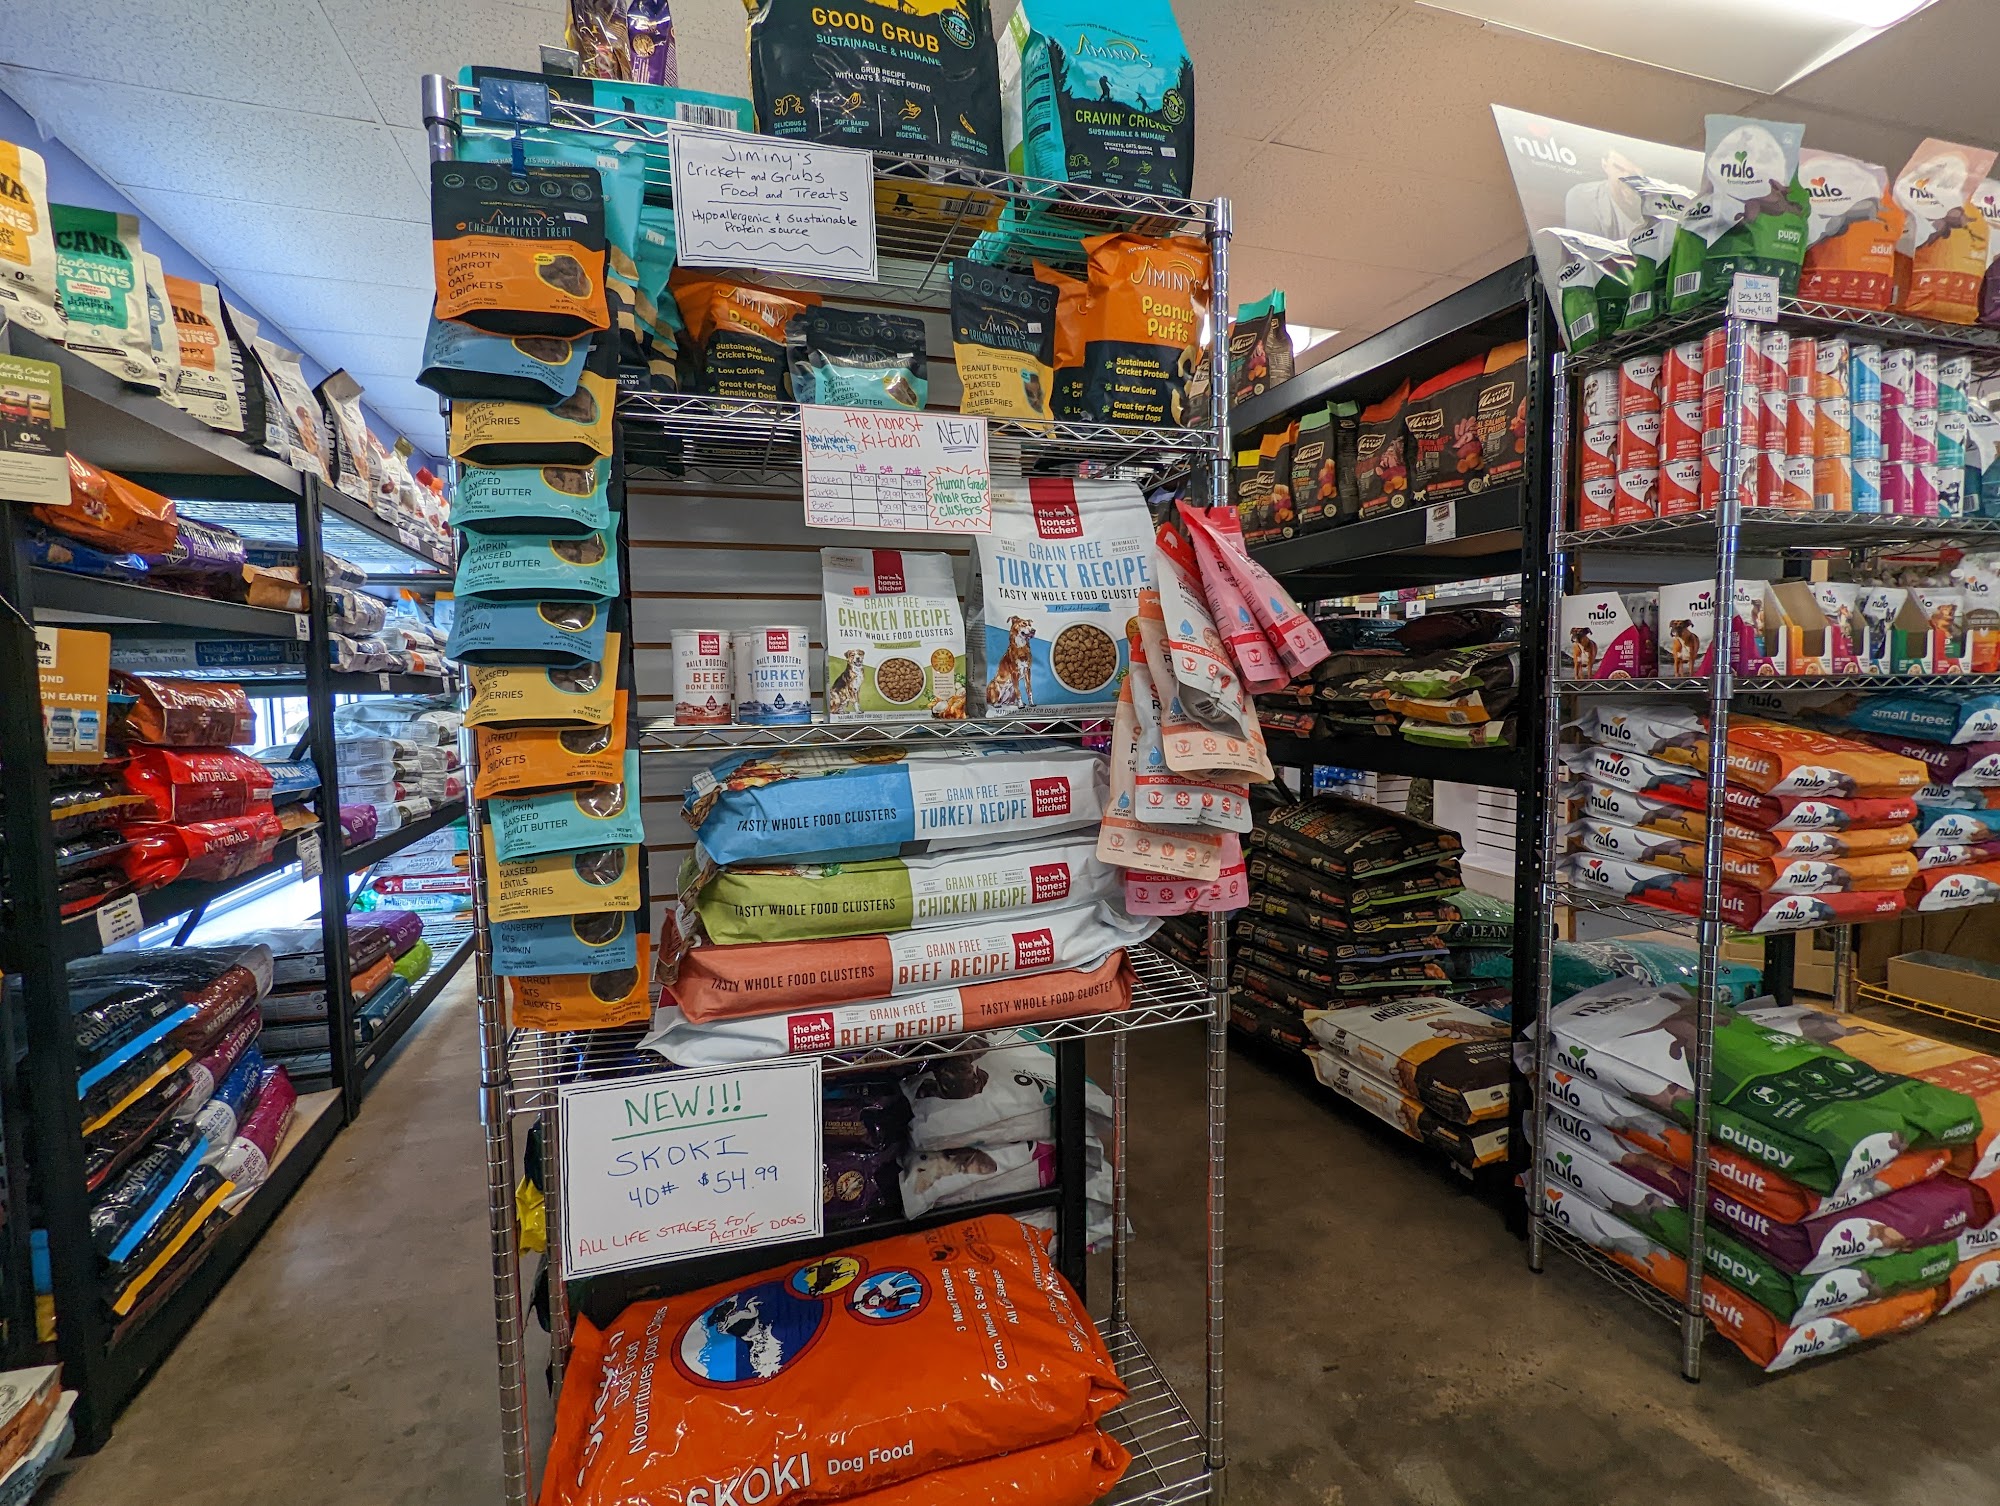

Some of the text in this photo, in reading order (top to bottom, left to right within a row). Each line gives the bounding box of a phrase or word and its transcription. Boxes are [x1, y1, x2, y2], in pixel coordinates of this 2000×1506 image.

[811, 7, 940, 54] GOOD GRUB
[948, 21, 967, 37] USA
[816, 33, 942, 67] SUSTAINABLE & HUMANE
[860, 65, 906, 80] GRUB RECIPE
[834, 71, 854, 80] WITH
[855, 73, 874, 82] OATS
[881, 75, 906, 88] SWEET
[906, 80, 931, 94] POTATO
[773, 119, 801, 130] DELICIOUS
[834, 118, 870, 128] SOFT BAKED
[901, 123, 922, 133] HIGHLY
[1075, 109, 1174, 134] CRAVIN' CRICKET
[841, 125, 863, 135] KIBBLE
[895, 130, 929, 142] DIGESTIBLE
[1088, 127, 1134, 139] SUSTAINABLE
[1140, 131, 1166, 143] HUMANE
[1513, 134, 1578, 167] nulo
[687, 161, 826, 184] Cricket and Grubs
[1719, 158, 1755, 180] nulo
[720, 183, 849, 203] Food and Treats
[691, 208, 772, 229] Hypoallergenic
[504, 225, 542, 238] CRICKET
[545, 226, 572, 238] TREAT
[724, 220, 812, 238] Protein source
[447, 251, 501, 266] PUMPKIN
[447, 260, 493, 277] CARROT
[1558, 260, 1581, 284] nulo
[448, 272, 475, 288] OATS
[449, 280, 504, 301] CRICKETS
[1141, 295, 1195, 325] Peanut
[1146, 317, 1189, 344] Puffs
[961, 364, 1019, 374] PEANUT BUTTER
[1115, 356, 1160, 371] Sustainable
[1632, 365, 1656, 377] nulo
[962, 371, 999, 381] CRICKETS
[1115, 366, 1170, 380] Cricket Protein
[1114, 384, 1157, 397] Low Calorie
[966, 398, 1014, 408] BLUEBERRIES
[1113, 401, 1164, 414] Great for Food
[844, 412, 924, 432] the honest
[1111, 409, 1162, 423] Sensitive Dogs
[936, 420, 980, 445] NEW
[1590, 433, 1611, 444] nulo
[861, 432, 921, 450] Kitchen
[879, 465, 894, 475] 5#
[1676, 467, 1701, 479] nulo
[935, 477, 988, 491] Human Grade
[932, 493, 982, 505] Whole Food
[1037, 508, 1055, 518] the
[1039, 516, 1077, 527] honest
[1040, 524, 1078, 535] kitchen
[1028, 541, 1102, 562] GRAIN FREE
[468, 559, 541, 576] PEANUT BUTTER
[995, 554, 1151, 589] TURKEY RECIPE
[998, 587, 1098, 602] TASTY WHOLE FOOD
[863, 596, 920, 610] GRAIN FREE
[838, 607, 953, 632] CHICKEN RECIPE
[1588, 606, 1618, 621] nulo
[839, 626, 954, 641] TASTY WHOLE FOOD CLUSTERS
[692, 672, 726, 684] BEEF
[754, 669, 806, 682] TURKEY
[58, 692, 97, 703] EARTH
[1870, 708, 1954, 727] small breed
[1726, 755, 1771, 776] adult
[190, 770, 238, 784] NATURALS
[1793, 775, 1825, 790] nulo
[736, 807, 898, 832] TASTY WHOLE FOOD CLUSTERS
[920, 798, 1028, 830] TURKEY RECIPE
[1471, 924, 1509, 938] LEAN
[898, 952, 1010, 986] BEEF RECIPE
[1556, 1051, 1599, 1082] nulo
[623, 1079, 742, 1127] NEW!!!
[1718, 1122, 1796, 1171] puppy
[607, 1134, 749, 1177] SKOKI
[629, 1165, 779, 1208] 40# $54.99
[1712, 1197, 1771, 1237] adult
[709, 1213, 807, 1243] ACTIVE DOGS
[579, 1238, 608, 1258] ALL
[612, 1229, 650, 1248] LIFE
[655, 1219, 717, 1239] STAGES
[628, 1361, 655, 1455] Nourritures
[827, 1439, 915, 1477] Dog Food
[686, 1451, 812, 1506] SKOKI
